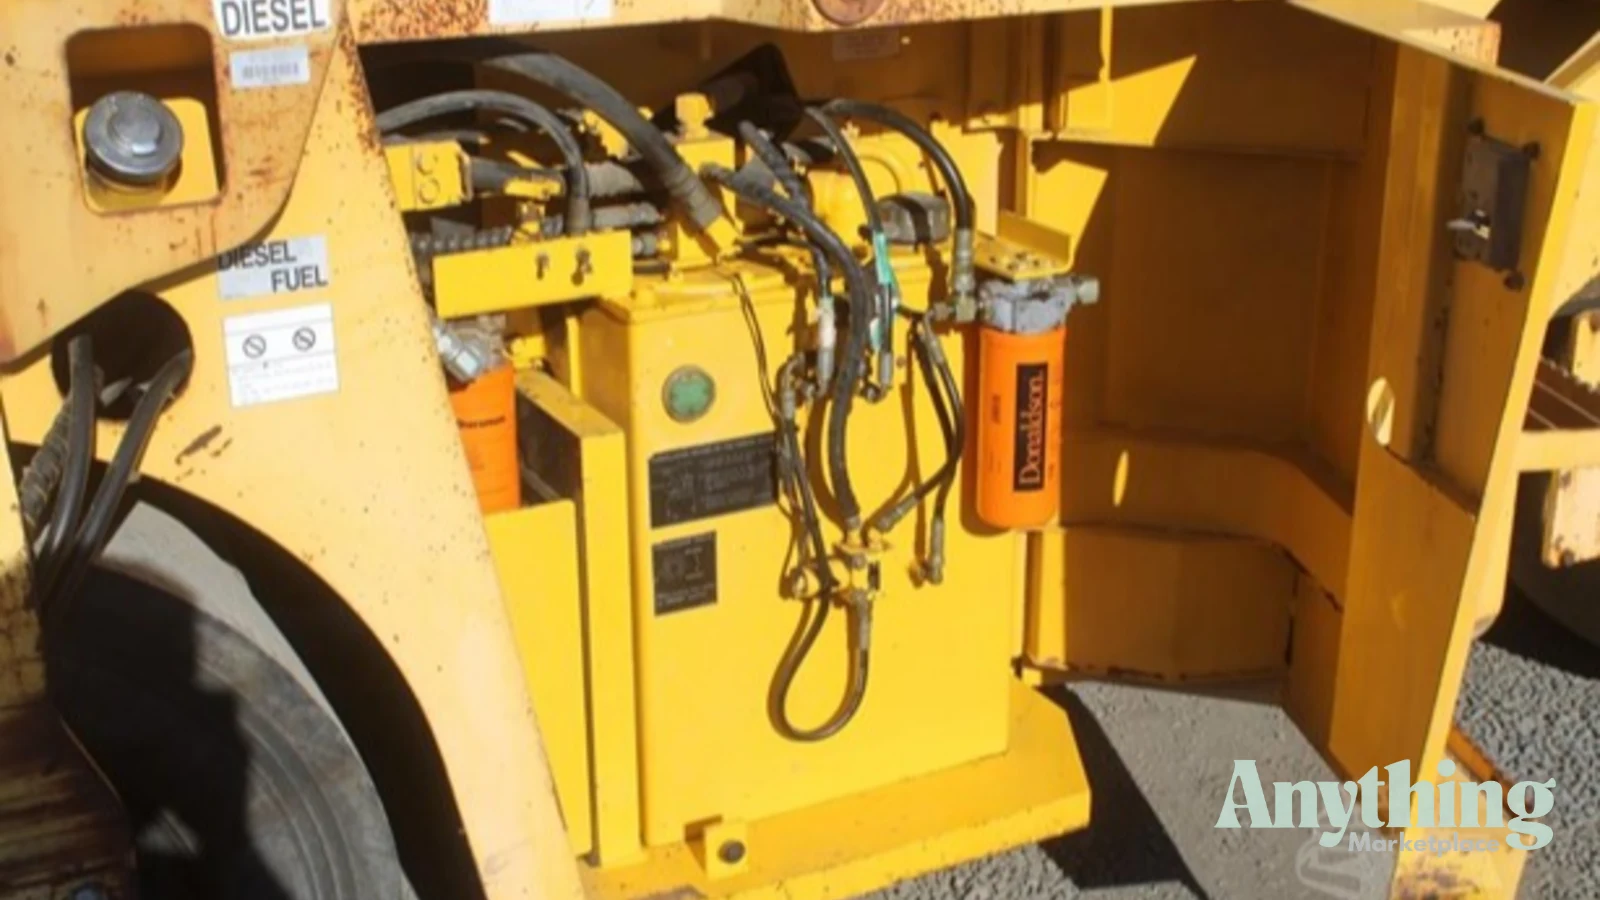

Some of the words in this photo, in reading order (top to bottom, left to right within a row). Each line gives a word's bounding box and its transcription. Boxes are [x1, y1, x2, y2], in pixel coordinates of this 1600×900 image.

[221, 0, 326, 36] DIESEL
[217, 240, 297, 270] DIESEL
[271, 264, 329, 293] FUEL
